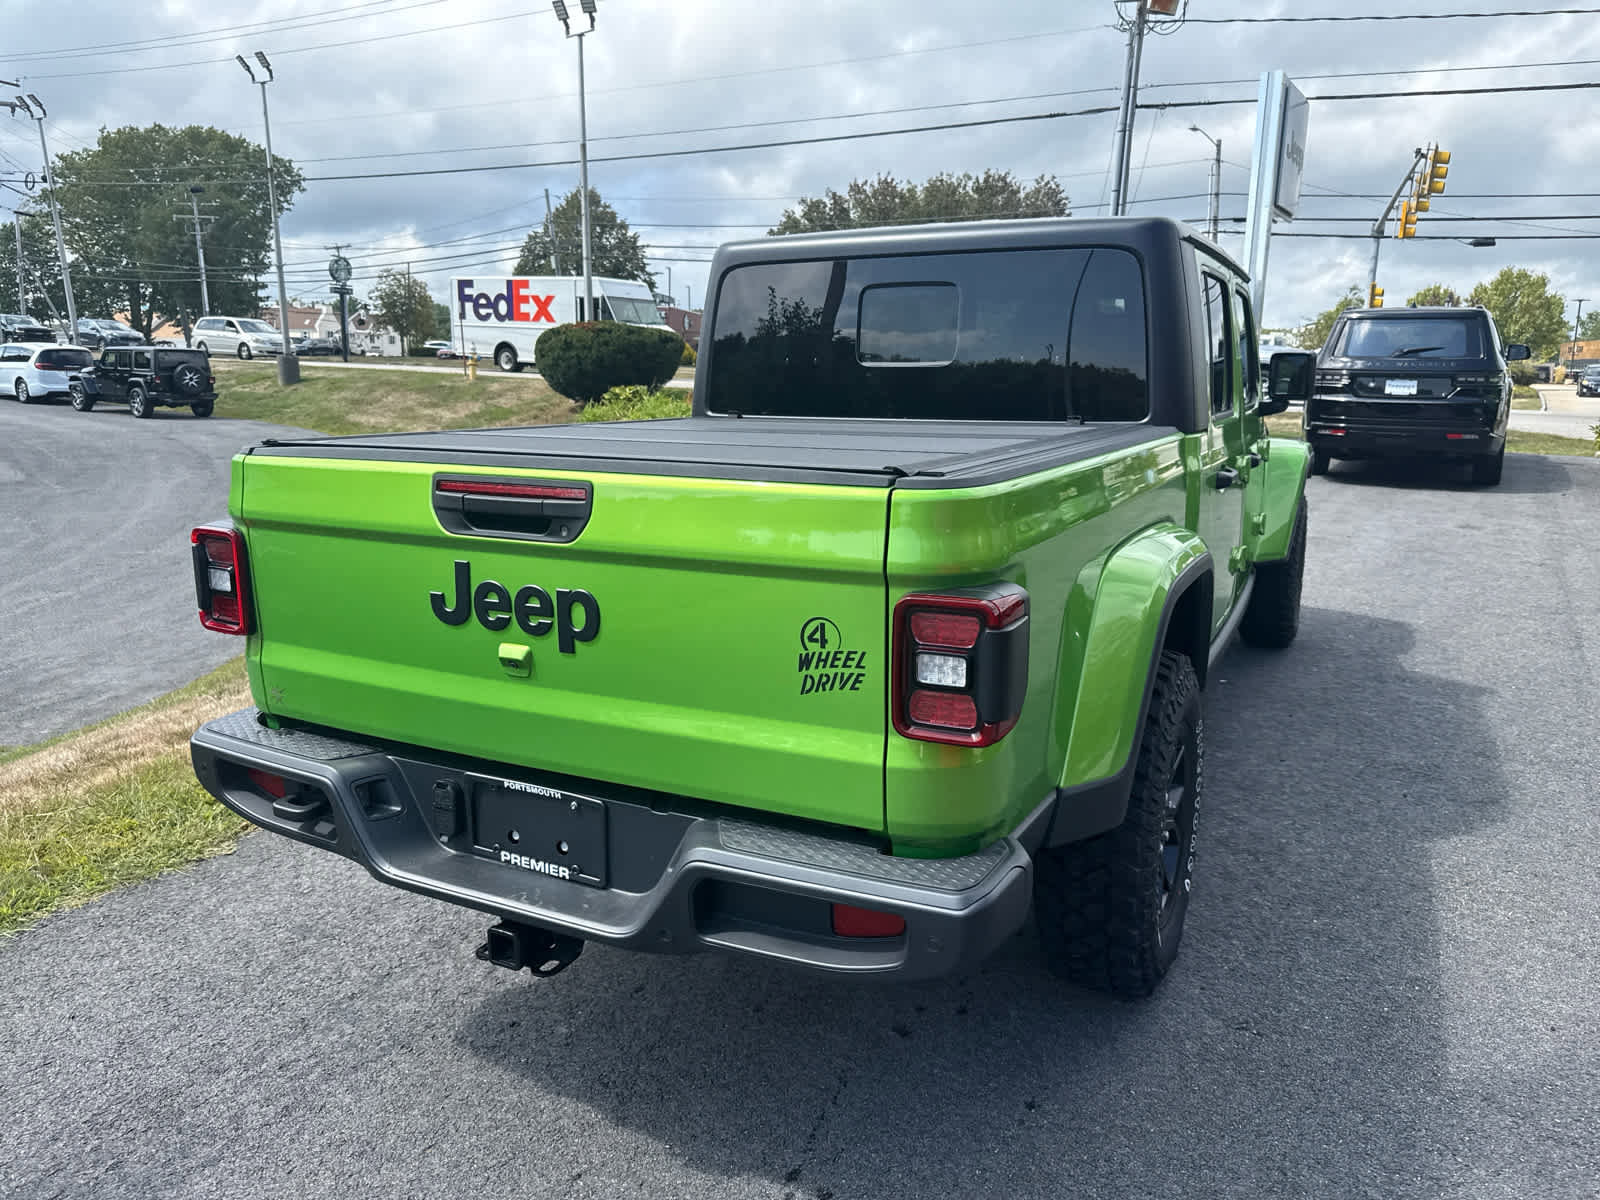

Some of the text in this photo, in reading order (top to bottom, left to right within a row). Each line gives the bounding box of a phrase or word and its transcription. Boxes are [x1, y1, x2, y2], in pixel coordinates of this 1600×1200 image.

[457, 280, 556, 322] FedEx
[429, 559, 601, 654] Jeep
[798, 650, 866, 672] WHEEL
[800, 672, 866, 695] DRIVE
[503, 781, 561, 799] PORTSMOUTH
[500, 850, 570, 880] PREMIER
